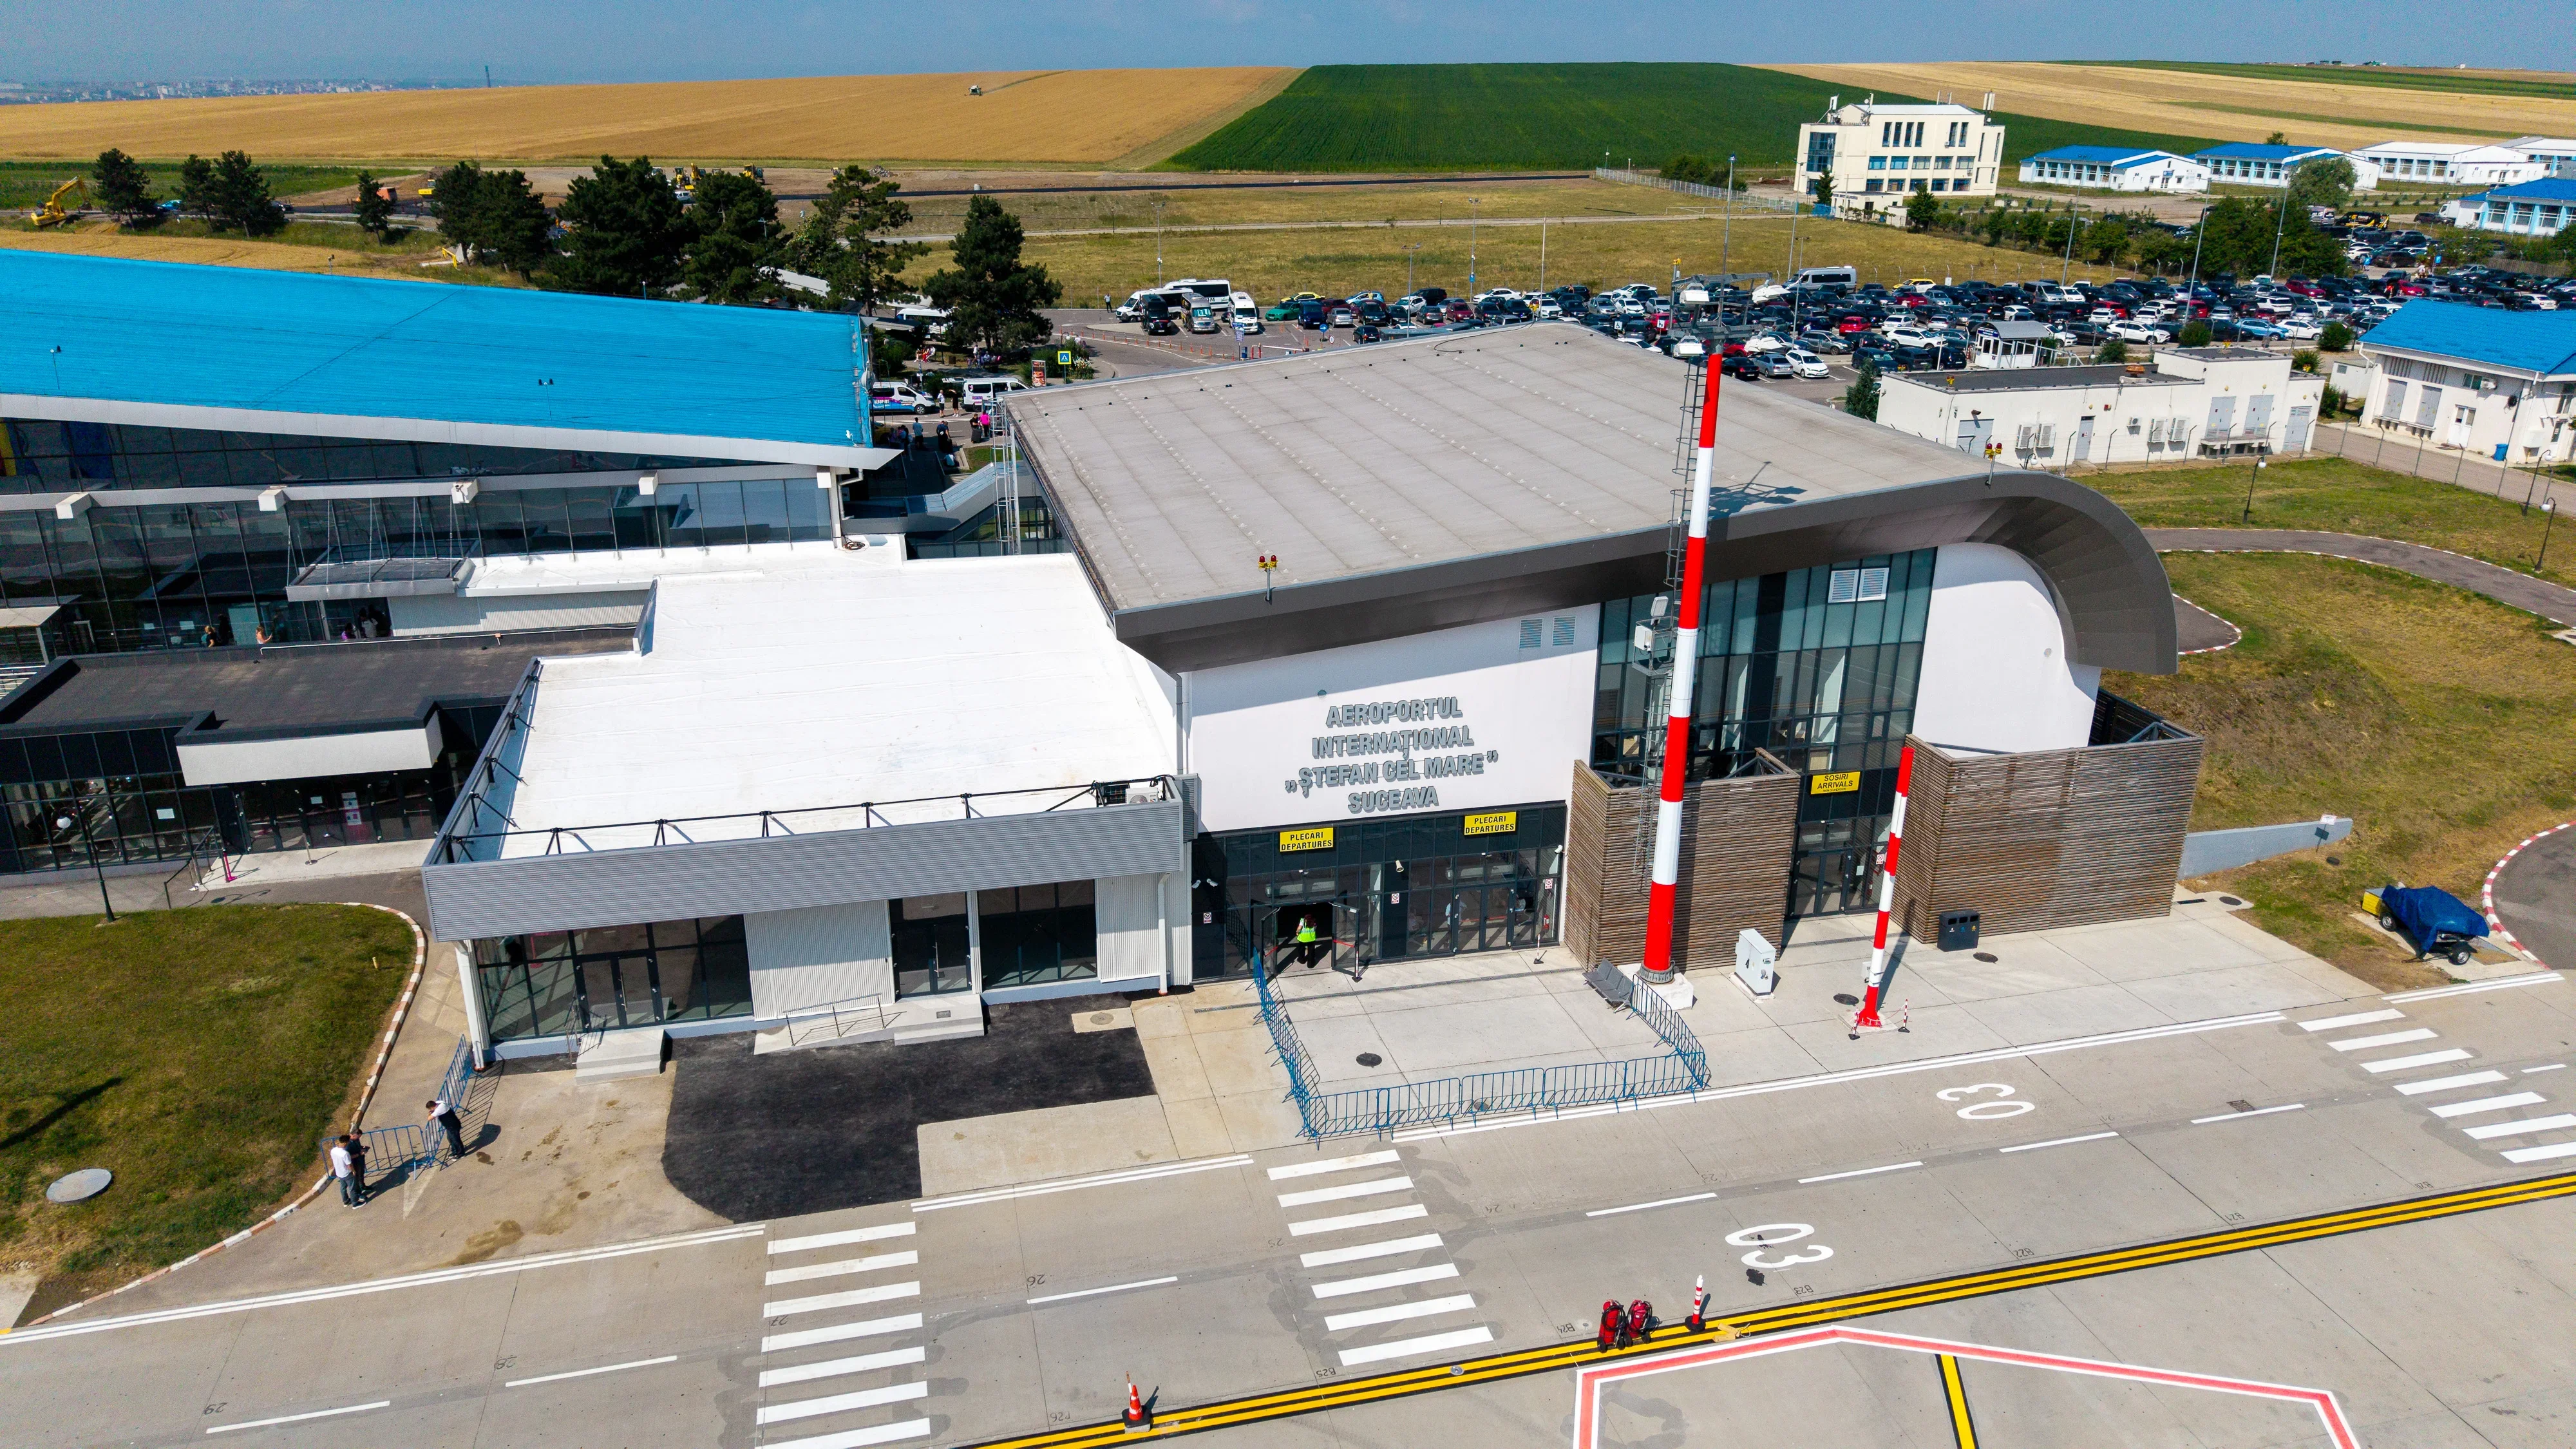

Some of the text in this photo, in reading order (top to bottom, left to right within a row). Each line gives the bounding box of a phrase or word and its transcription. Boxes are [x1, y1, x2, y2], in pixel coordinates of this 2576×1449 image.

[1325, 696, 1463, 728] AEROPORTUL
[1312, 725, 1475, 759] INTERNAȚIONAL
[1382, 759, 1421, 781] CEL
[1824, 773, 1849, 782] SOSIRI
[1817, 780, 1853, 790] ARRIVALS
[1347, 786, 1439, 813] SUCEAVA
[1465, 823, 1515, 834] DEPARTURES
[1281, 839, 1332, 851] DEPARTURES
[2224, 1212, 2244, 1223] B21
[2013, 1247, 2034, 1258] B22
[1026, 1274, 1046, 1287] 26
[1794, 1285, 1814, 1296] B23
[769, 1314, 790, 1327] 27
[1556, 1322, 1576, 1335] B24
[494, 1357, 517, 1370] 28
[1316, 1367, 1336, 1378] B25
[203, 1402, 227, 1416] 29
